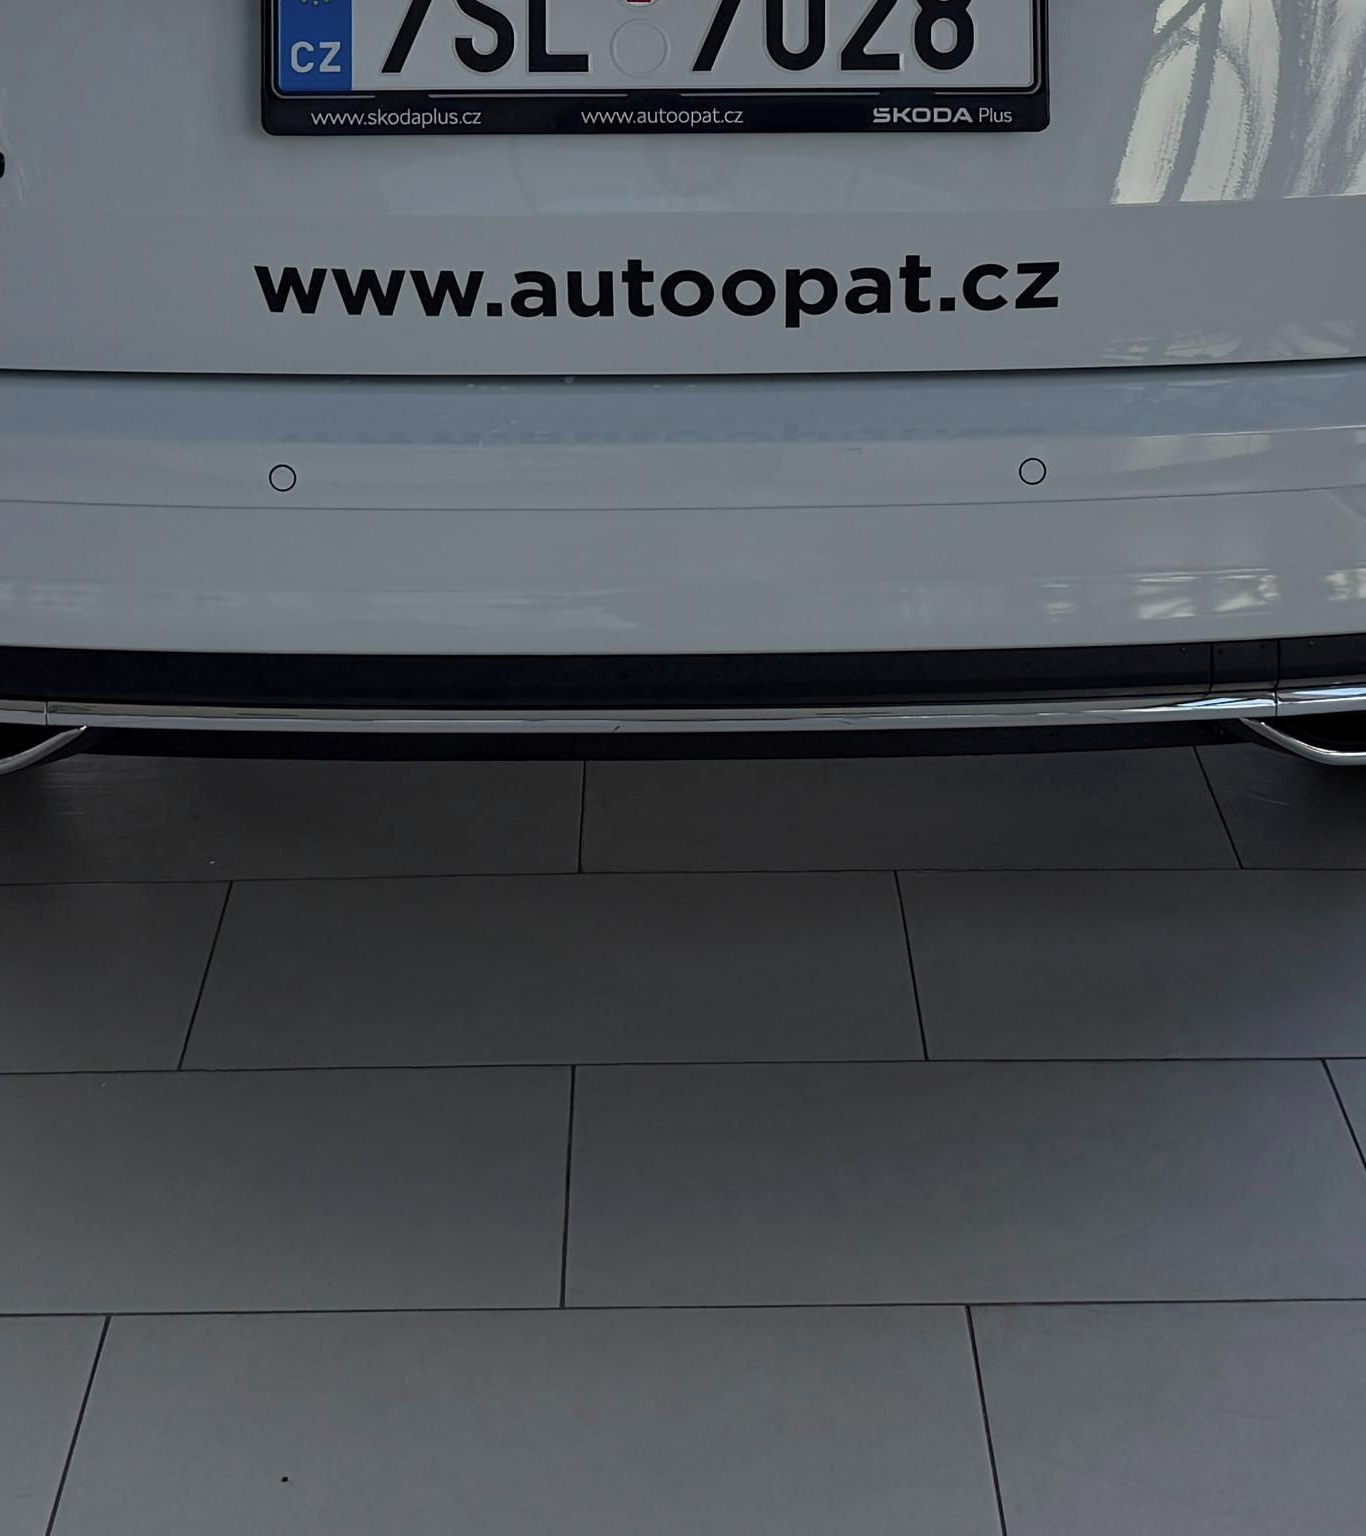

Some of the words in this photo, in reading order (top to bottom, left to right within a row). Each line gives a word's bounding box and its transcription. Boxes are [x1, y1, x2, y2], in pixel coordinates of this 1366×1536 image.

[290, 40, 341, 73] CZ
[310, 107, 482, 129] www.skodaplus.cz
[580, 107, 744, 128] www.autoopat.cz
[978, 107, 1013, 123] Plus
[253, 254, 1060, 329] www.autoopat.cz
